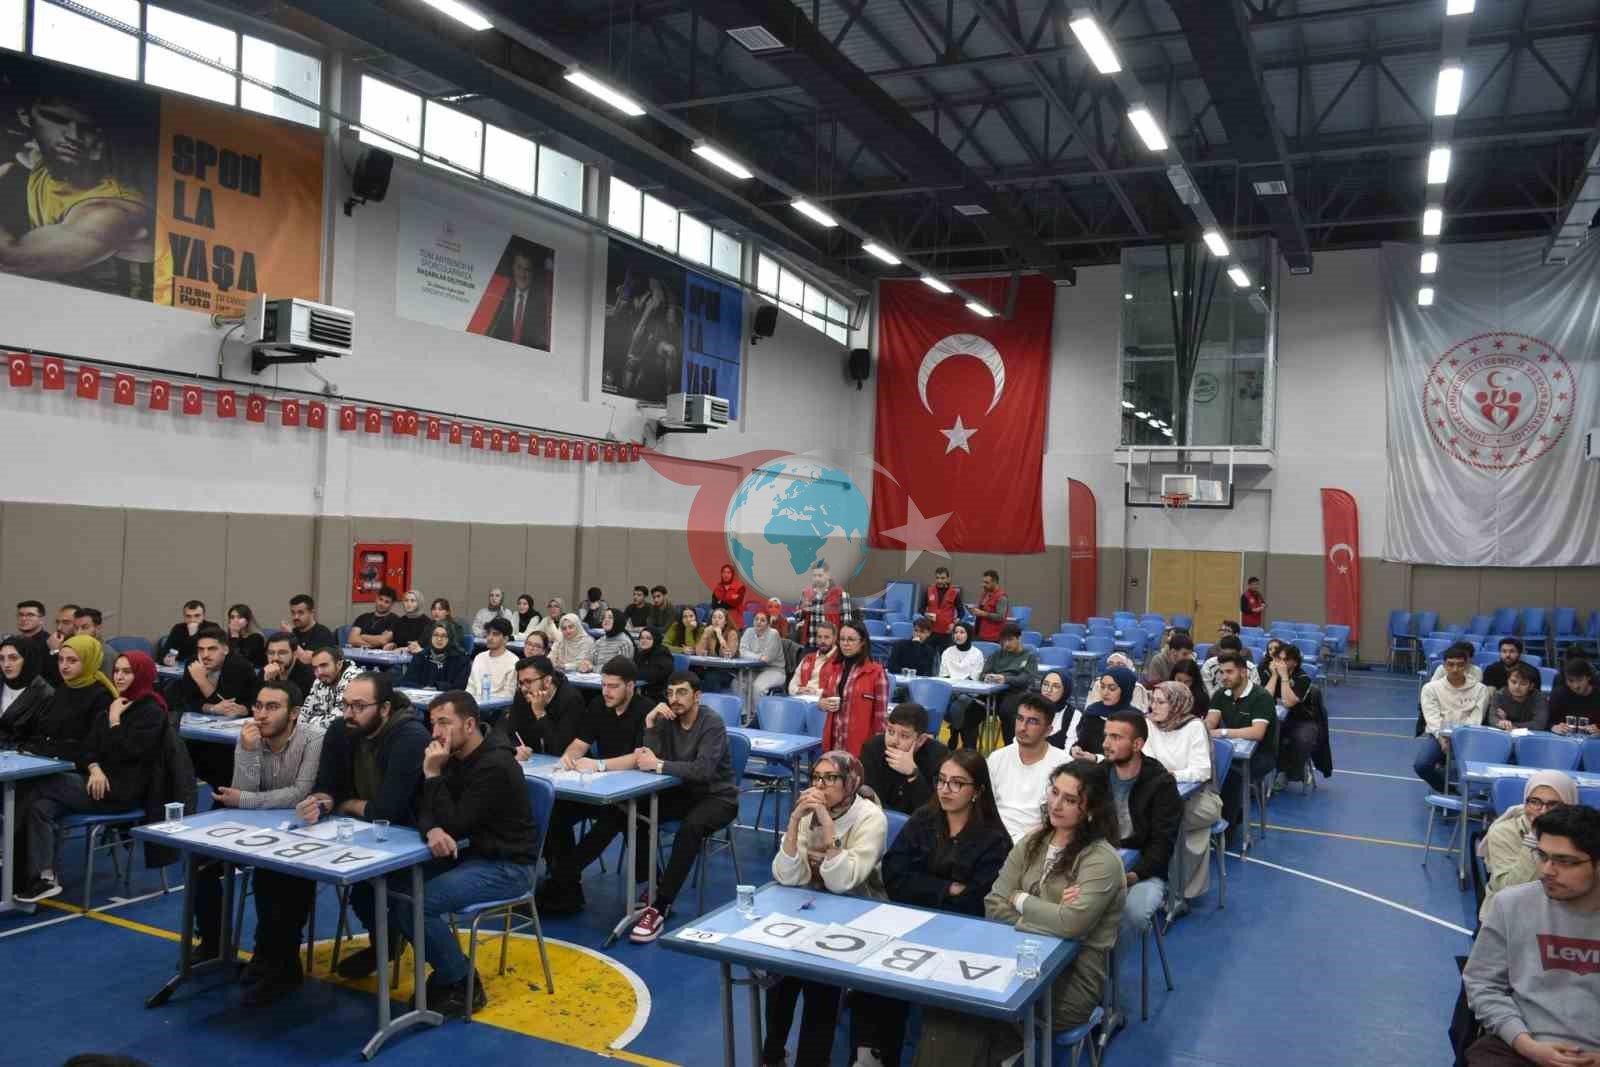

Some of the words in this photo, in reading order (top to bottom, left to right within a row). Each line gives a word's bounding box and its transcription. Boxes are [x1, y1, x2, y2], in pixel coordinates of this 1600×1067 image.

[173, 180, 215, 230] LA
[168, 232, 258, 293] YAŞA
[206, 826, 246, 839] D
[235, 834, 280, 847] C
[273, 842, 329, 858] B
[330, 851, 377, 865] A
[763, 921, 805, 938] D
[814, 933, 867, 953] C
[882, 947, 942, 973] B
[956, 958, 1003, 981] A
